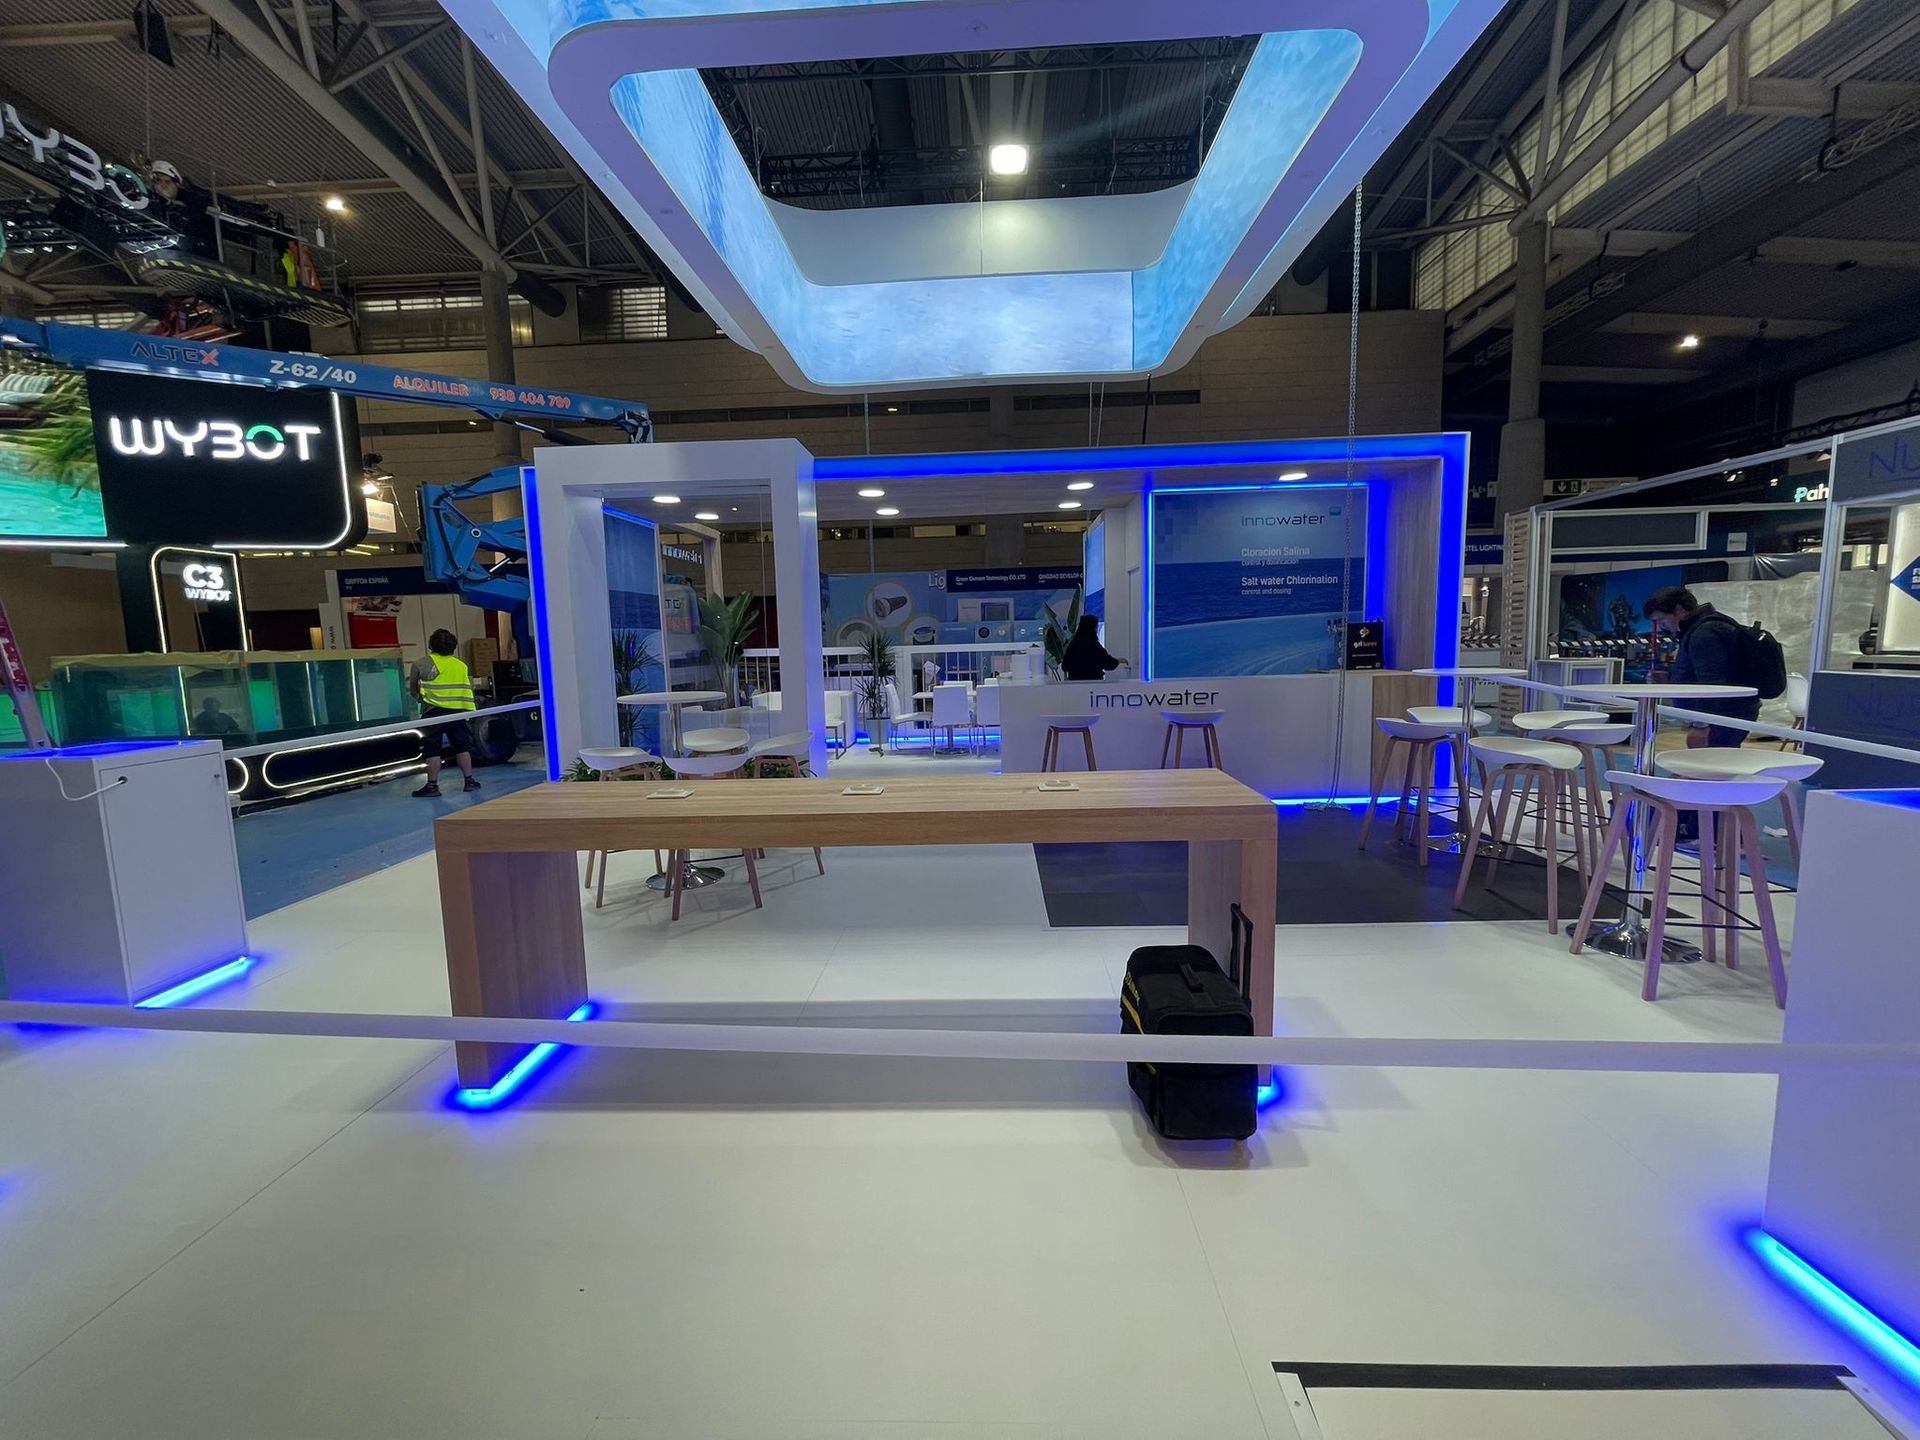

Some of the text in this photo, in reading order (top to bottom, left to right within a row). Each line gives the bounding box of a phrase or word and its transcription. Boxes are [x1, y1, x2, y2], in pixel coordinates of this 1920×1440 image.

[0, 103, 149, 210] YBO
[130, 342, 219, 367] ALTEX
[269, 360, 357, 384] Z-62/40
[393, 375, 469, 397] ALQUILER
[1241, 513, 1325, 527] innowater
[1283, 546, 1310, 556] Salina
[183, 564, 224, 589] C3
[1241, 574, 1338, 586] Salt water Chlorination
[1090, 689, 1219, 708] innowater
